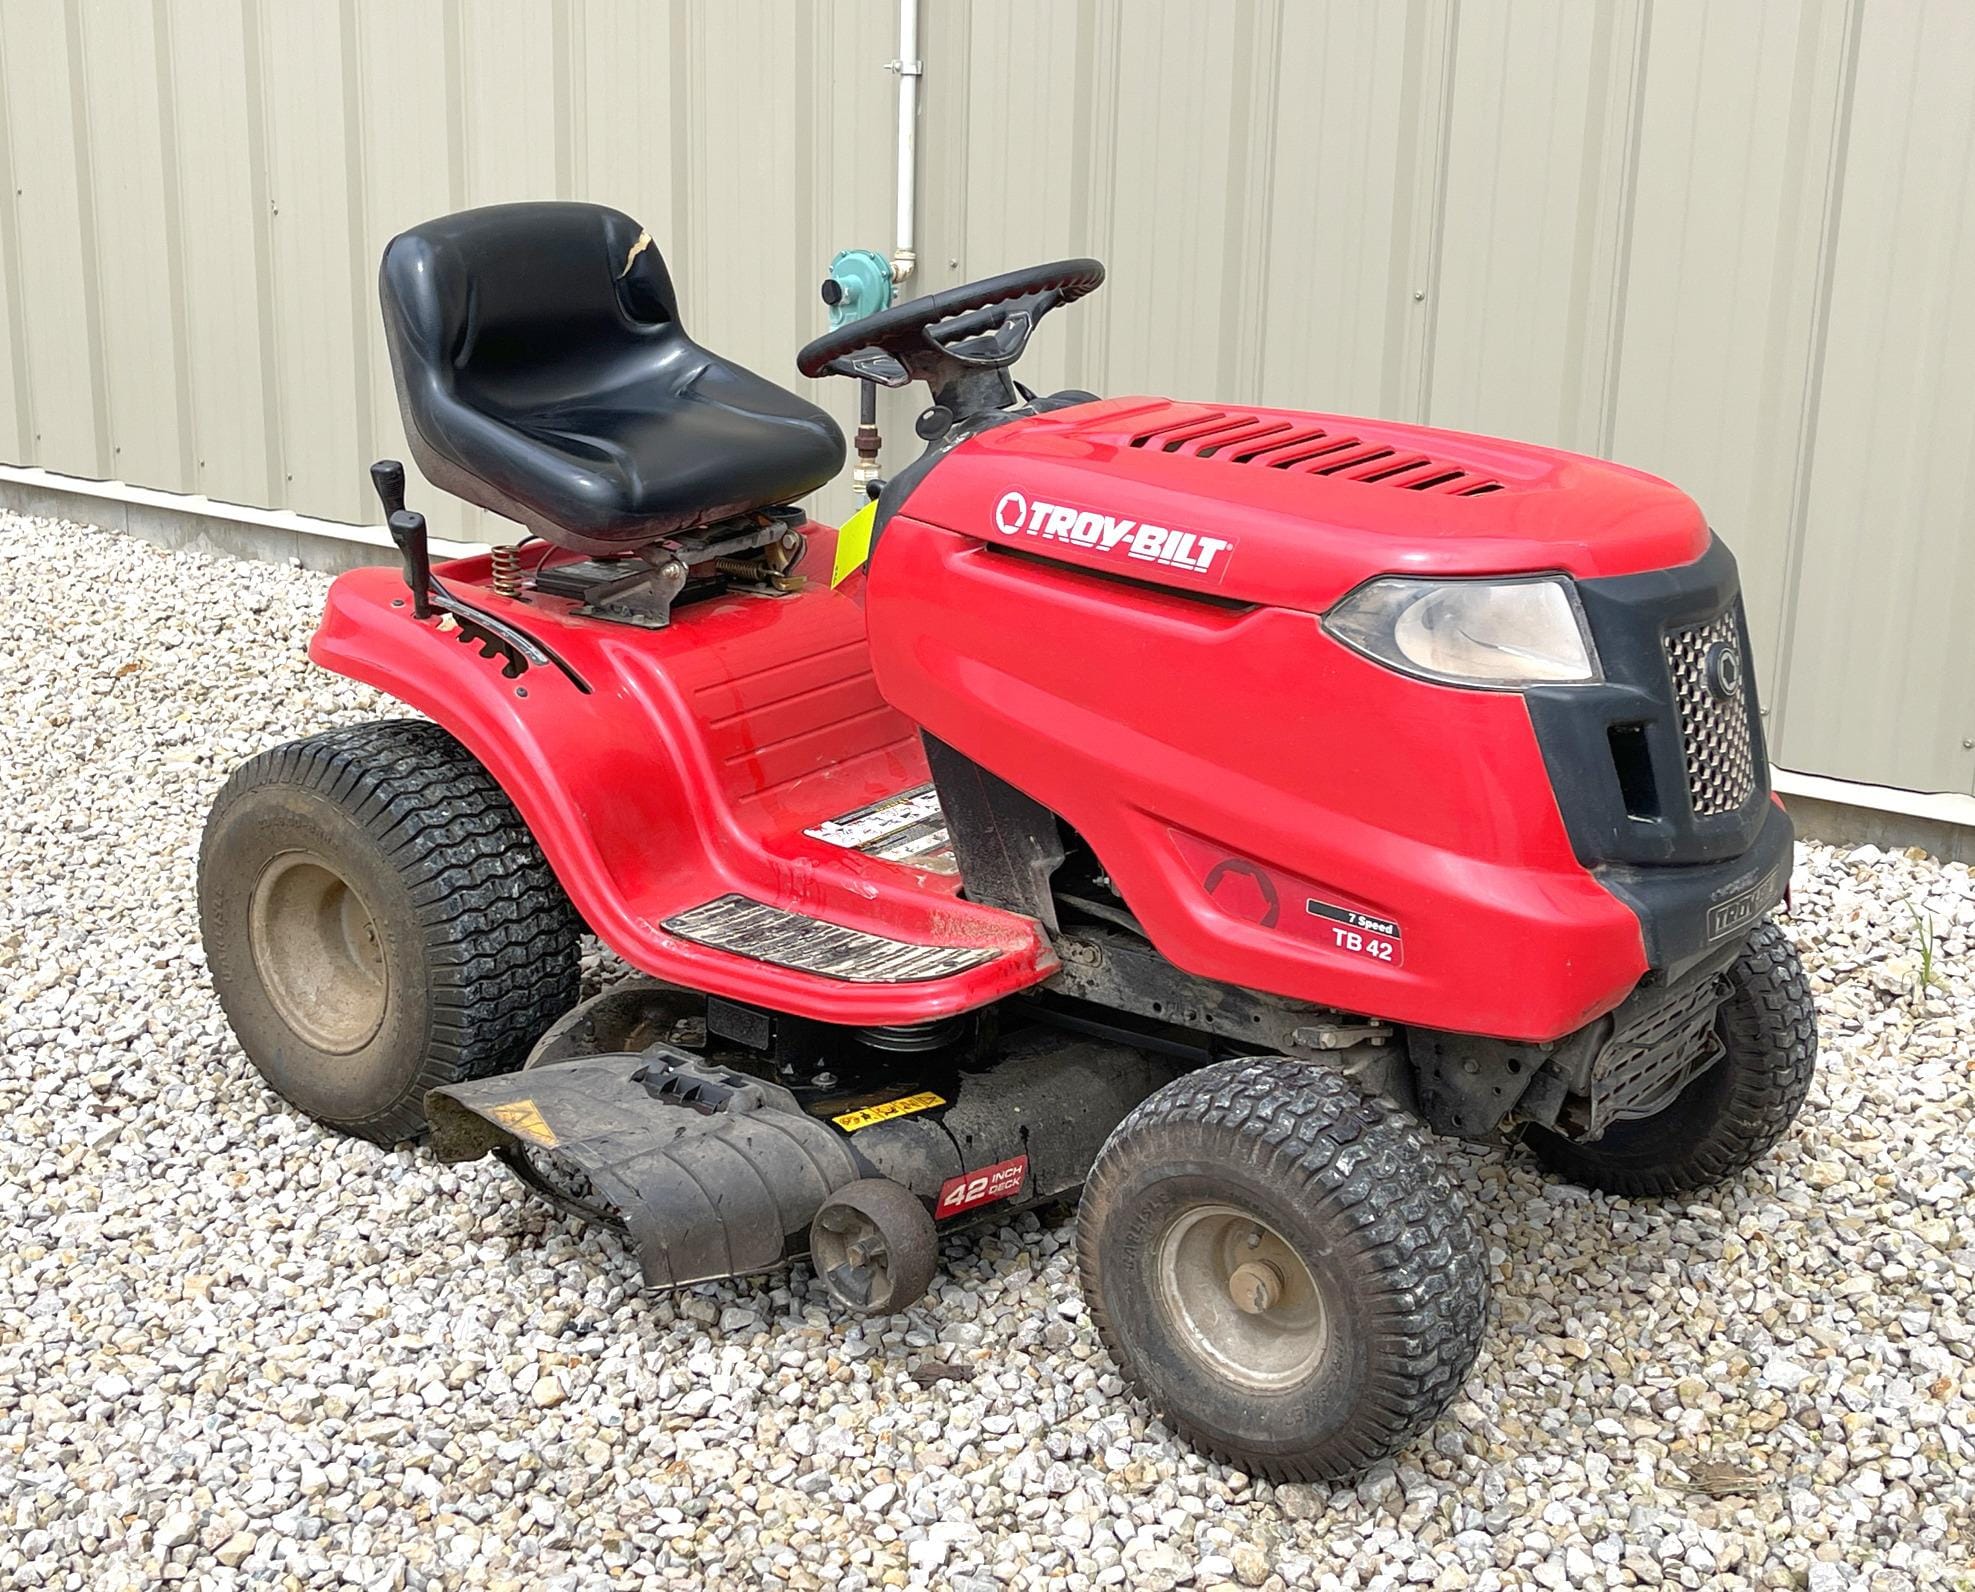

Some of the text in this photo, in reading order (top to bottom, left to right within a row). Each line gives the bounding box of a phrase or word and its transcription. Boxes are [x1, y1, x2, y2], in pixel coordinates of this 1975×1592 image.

[1348, 913, 1393, 935] 7 Speed
[1332, 927, 1393, 962] TB 42
[943, 1165, 1023, 1207] 42 INCH
[988, 1177, 1021, 1195] DECK
